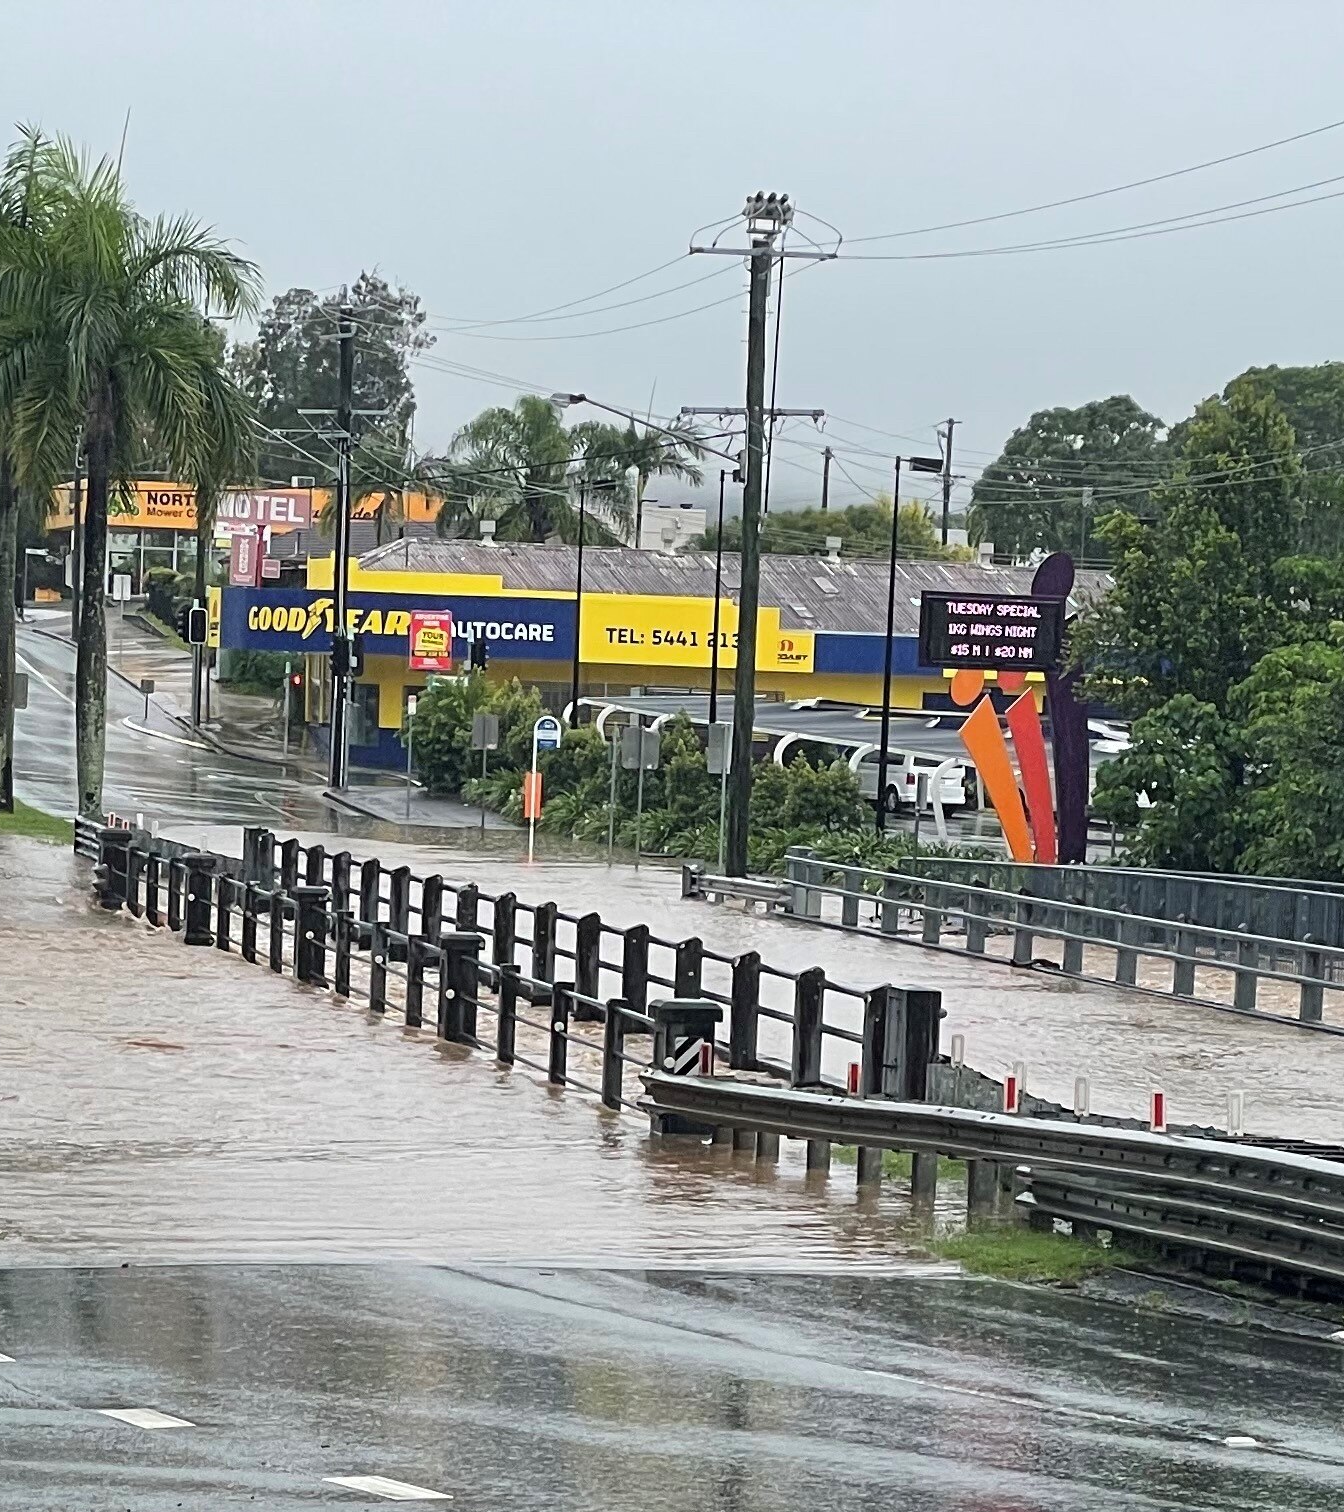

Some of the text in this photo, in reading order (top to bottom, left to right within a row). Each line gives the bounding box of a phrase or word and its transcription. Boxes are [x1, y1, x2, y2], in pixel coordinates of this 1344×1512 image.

[147, 507, 183, 517] Mower
[217, 491, 305, 523] MOTEL
[946, 602, 1041, 618] TUESDAY SPECIAL
[422, 631, 444, 641] YOUR
[606, 627, 645, 645] TEL:
[652, 629, 698, 647] 5441
[948, 623, 1037, 638] 1KG WINGS NIGHT
[950, 644, 970, 656] $15
[972, 645, 981, 656] M
[994, 646, 1016, 658] $20
